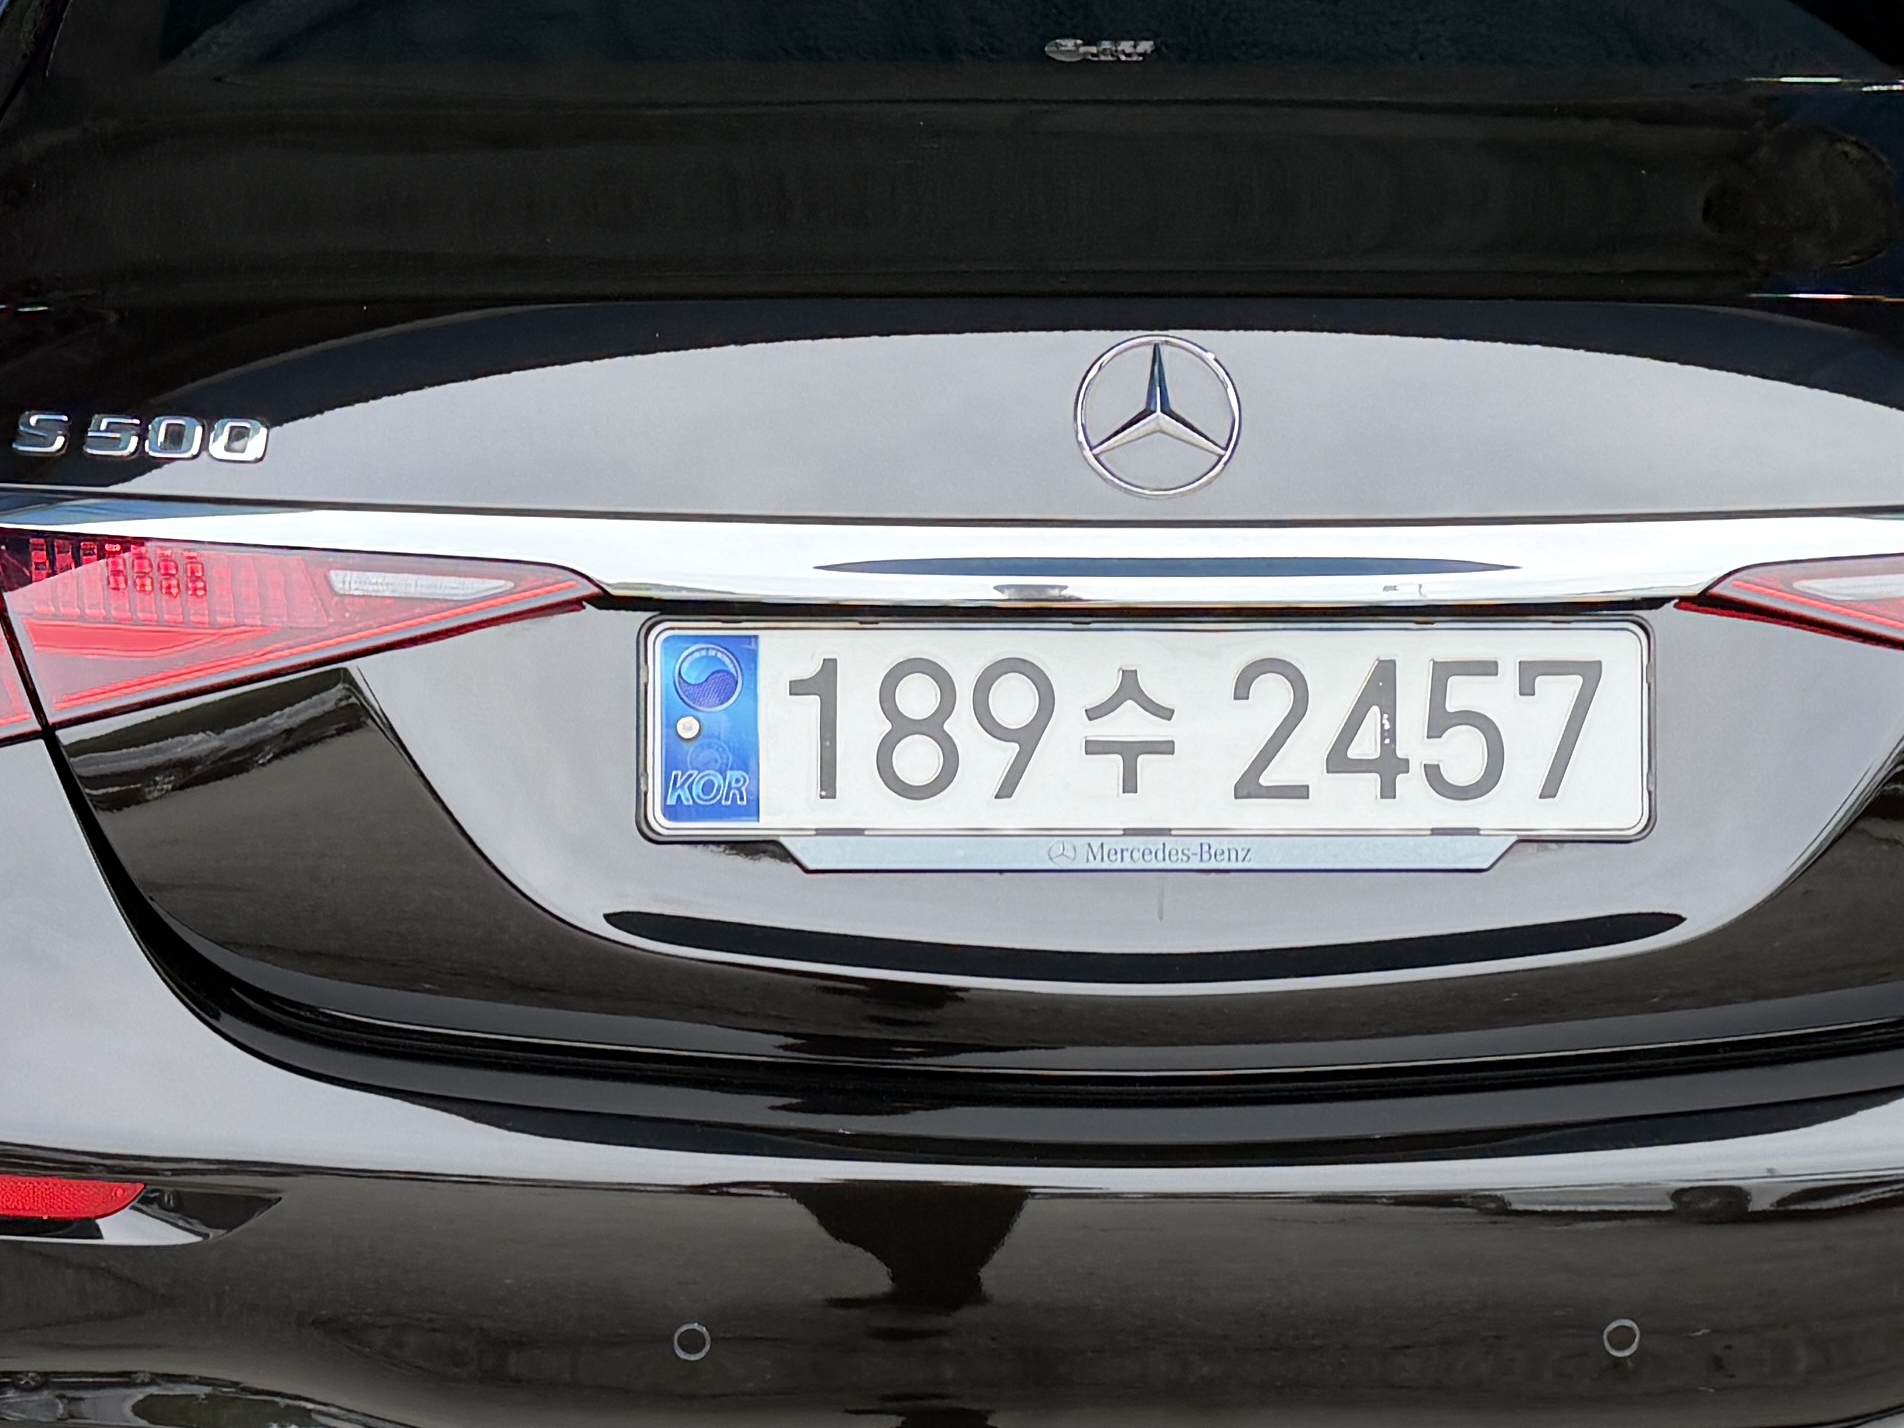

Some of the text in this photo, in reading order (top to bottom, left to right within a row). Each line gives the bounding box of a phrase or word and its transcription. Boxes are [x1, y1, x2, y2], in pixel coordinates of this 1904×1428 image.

[12, 410, 268, 462] S 500
[787, 655, 1603, 802] 189수 2457
[666, 769, 750, 806] KOR
[1085, 841, 1253, 864] Mercedes-Benz
